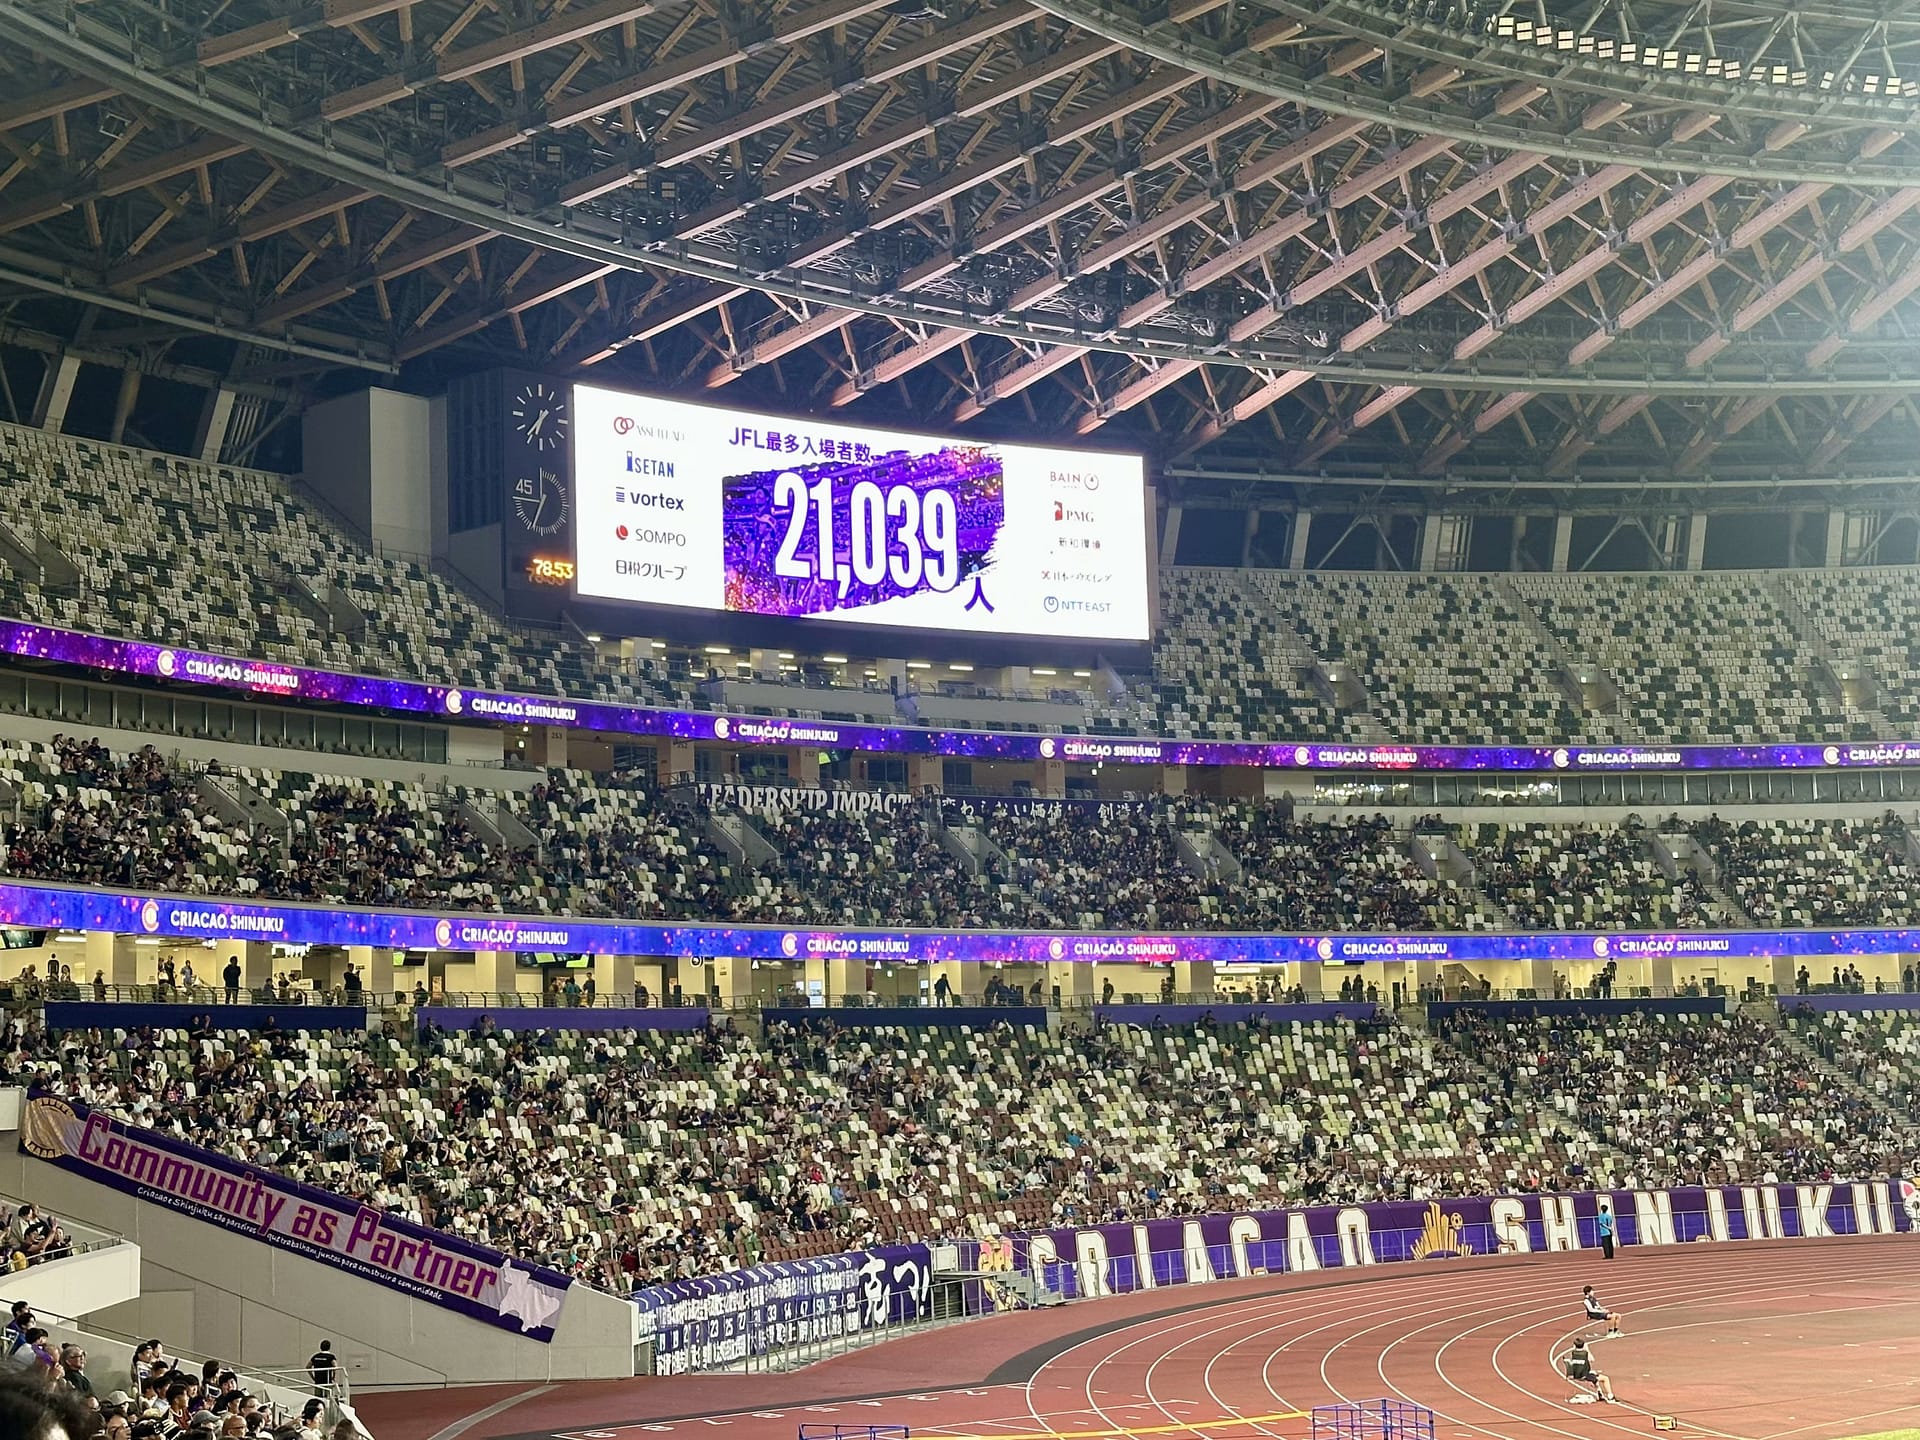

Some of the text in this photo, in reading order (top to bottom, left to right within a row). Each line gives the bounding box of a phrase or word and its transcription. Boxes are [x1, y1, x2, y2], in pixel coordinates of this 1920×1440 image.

[728, 427, 871, 463] JFL最多入場者数
[1050, 471, 1080, 483] BAIN
[515, 478, 533, 495] 45
[630, 492, 684, 511] vortex
[635, 528, 686, 547] SOMPO
[773, 471, 995, 614] 21,039 人
[186, 660, 299, 688] CRIACAO SHINJUKU
[471, 698, 577, 721] CRIACAO SHINJUKU
[738, 724, 838, 742] CRIACAO SHINJUKU
[1063, 743, 1162, 758] CRIACAO SHINJUKU
[1318, 751, 1418, 763] CRIACAO SHINJUKU
[1577, 752, 1681, 764] CRIACAO SHINJUKU
[1849, 749, 1903, 760] CRIACAO
[170, 910, 284, 932] CRIACAO SHINJUKU
[462, 927, 568, 945] CRIACAO SHINJUKU
[807, 939, 909, 953] CRIACAO SHINJUKU
[1074, 943, 1176, 955] CRIACAO SHINJUKU
[1342, 943, 1447, 955] CRIACAO SHINJUKU
[1619, 940, 1729, 952] CRIACAO SHINJUKU
[78, 1111, 497, 1299] Community as Partner
[172, 1198, 213, 1219] Shinjuku
[340, 1258, 358, 1270] para
[398, 1280, 443, 1300] comunidade
[710, 1319, 719, 1338] 23
[767, 1304, 777, 1321] 33
[816, 1298, 825, 1316] 50
